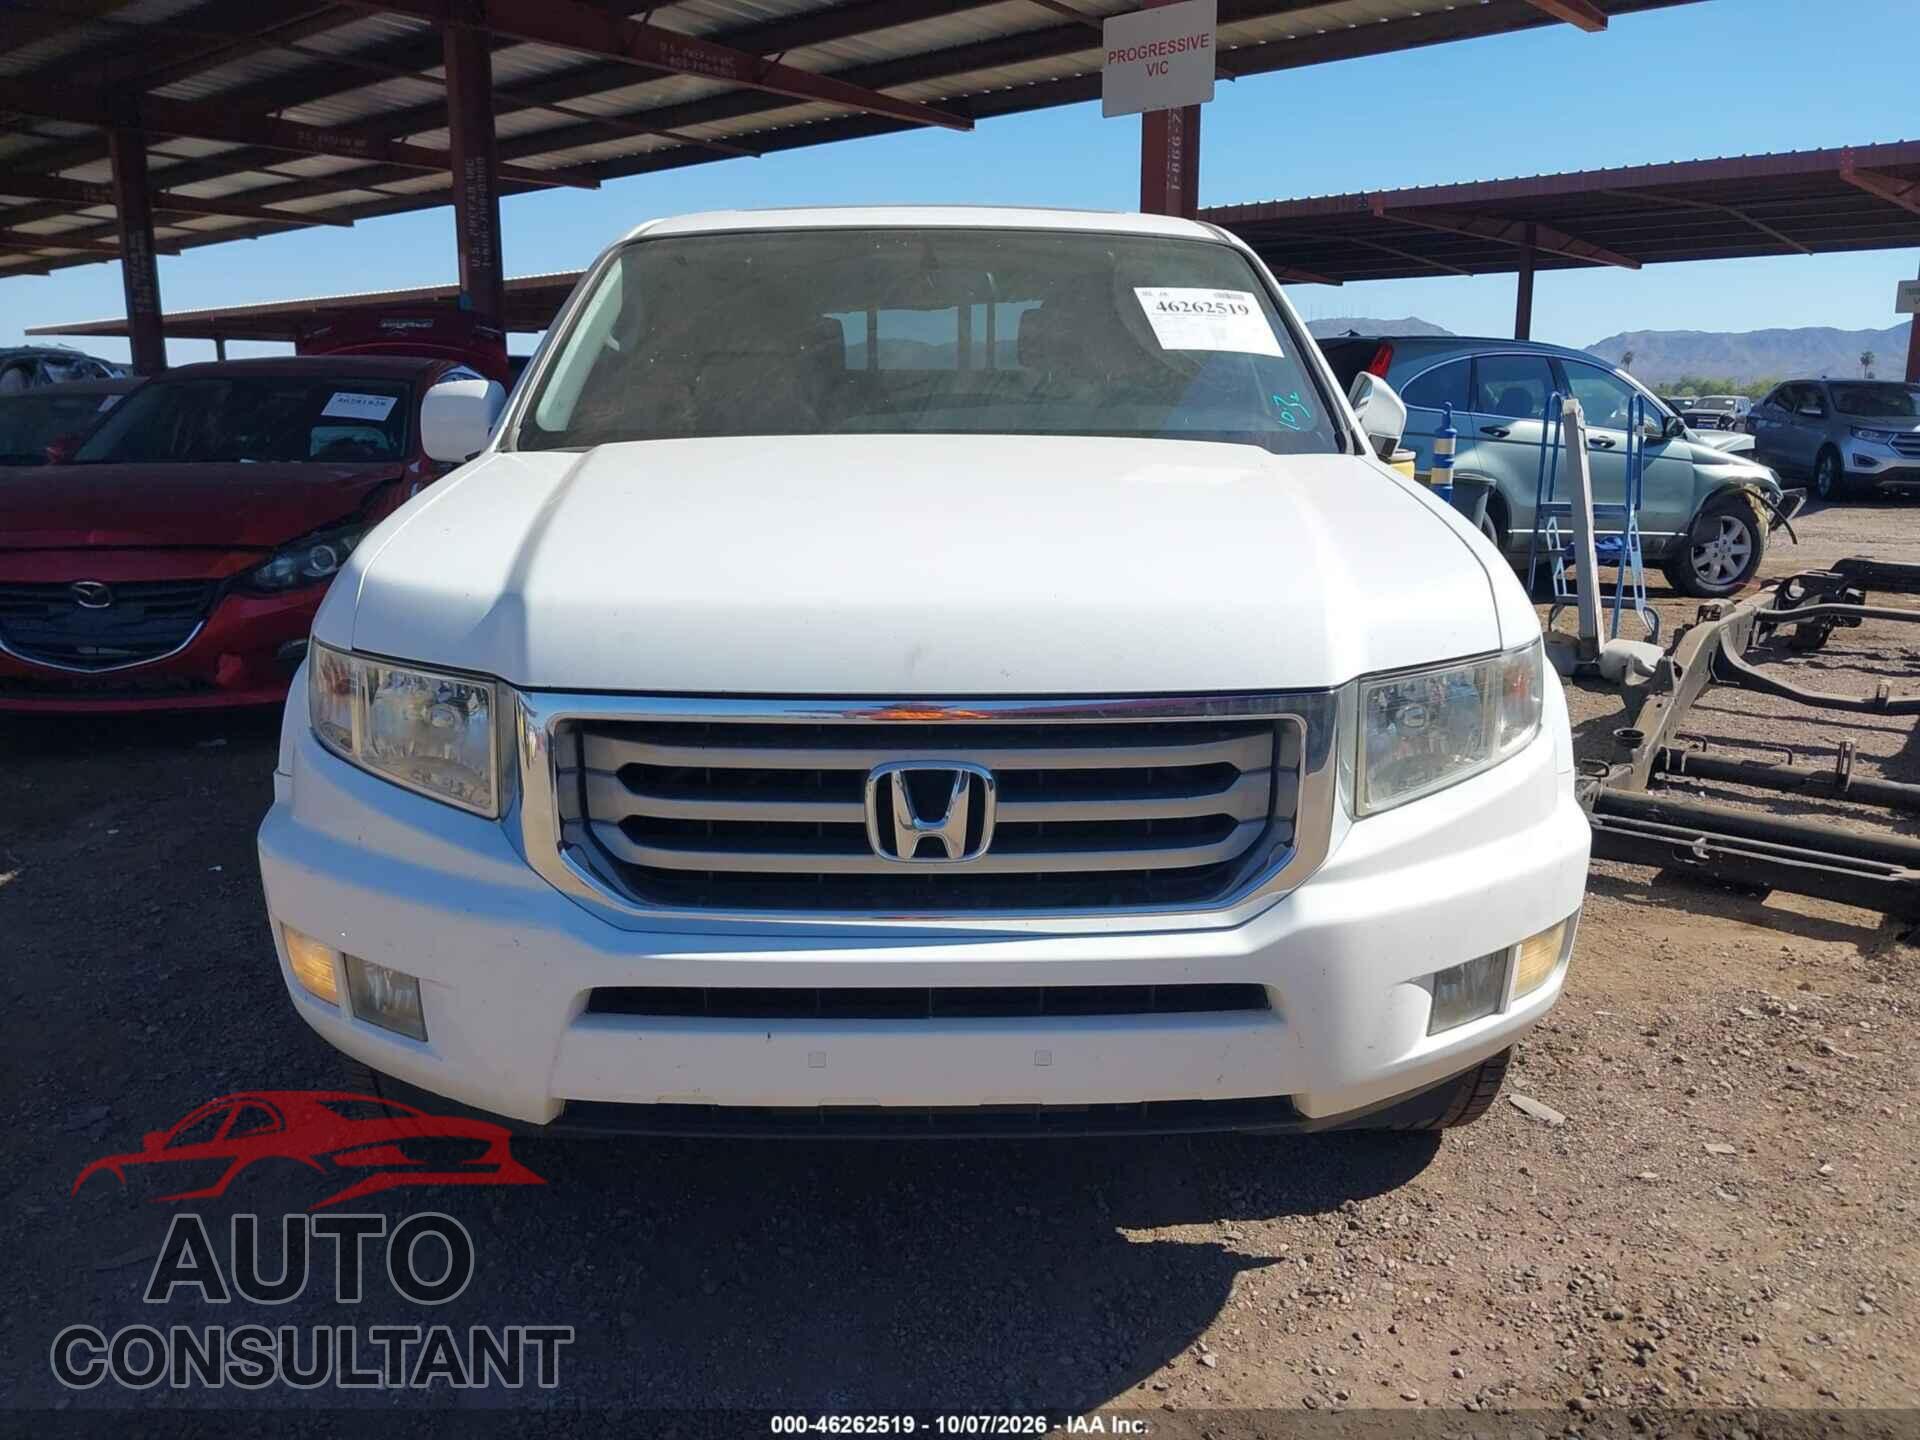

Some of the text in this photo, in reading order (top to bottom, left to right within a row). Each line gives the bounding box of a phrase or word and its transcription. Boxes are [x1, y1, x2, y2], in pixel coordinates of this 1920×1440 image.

[1108, 33, 1209, 64] PROGRESSIVE
[1146, 61, 1169, 77] VIC
[1156, 300, 1249, 315] 46262519
